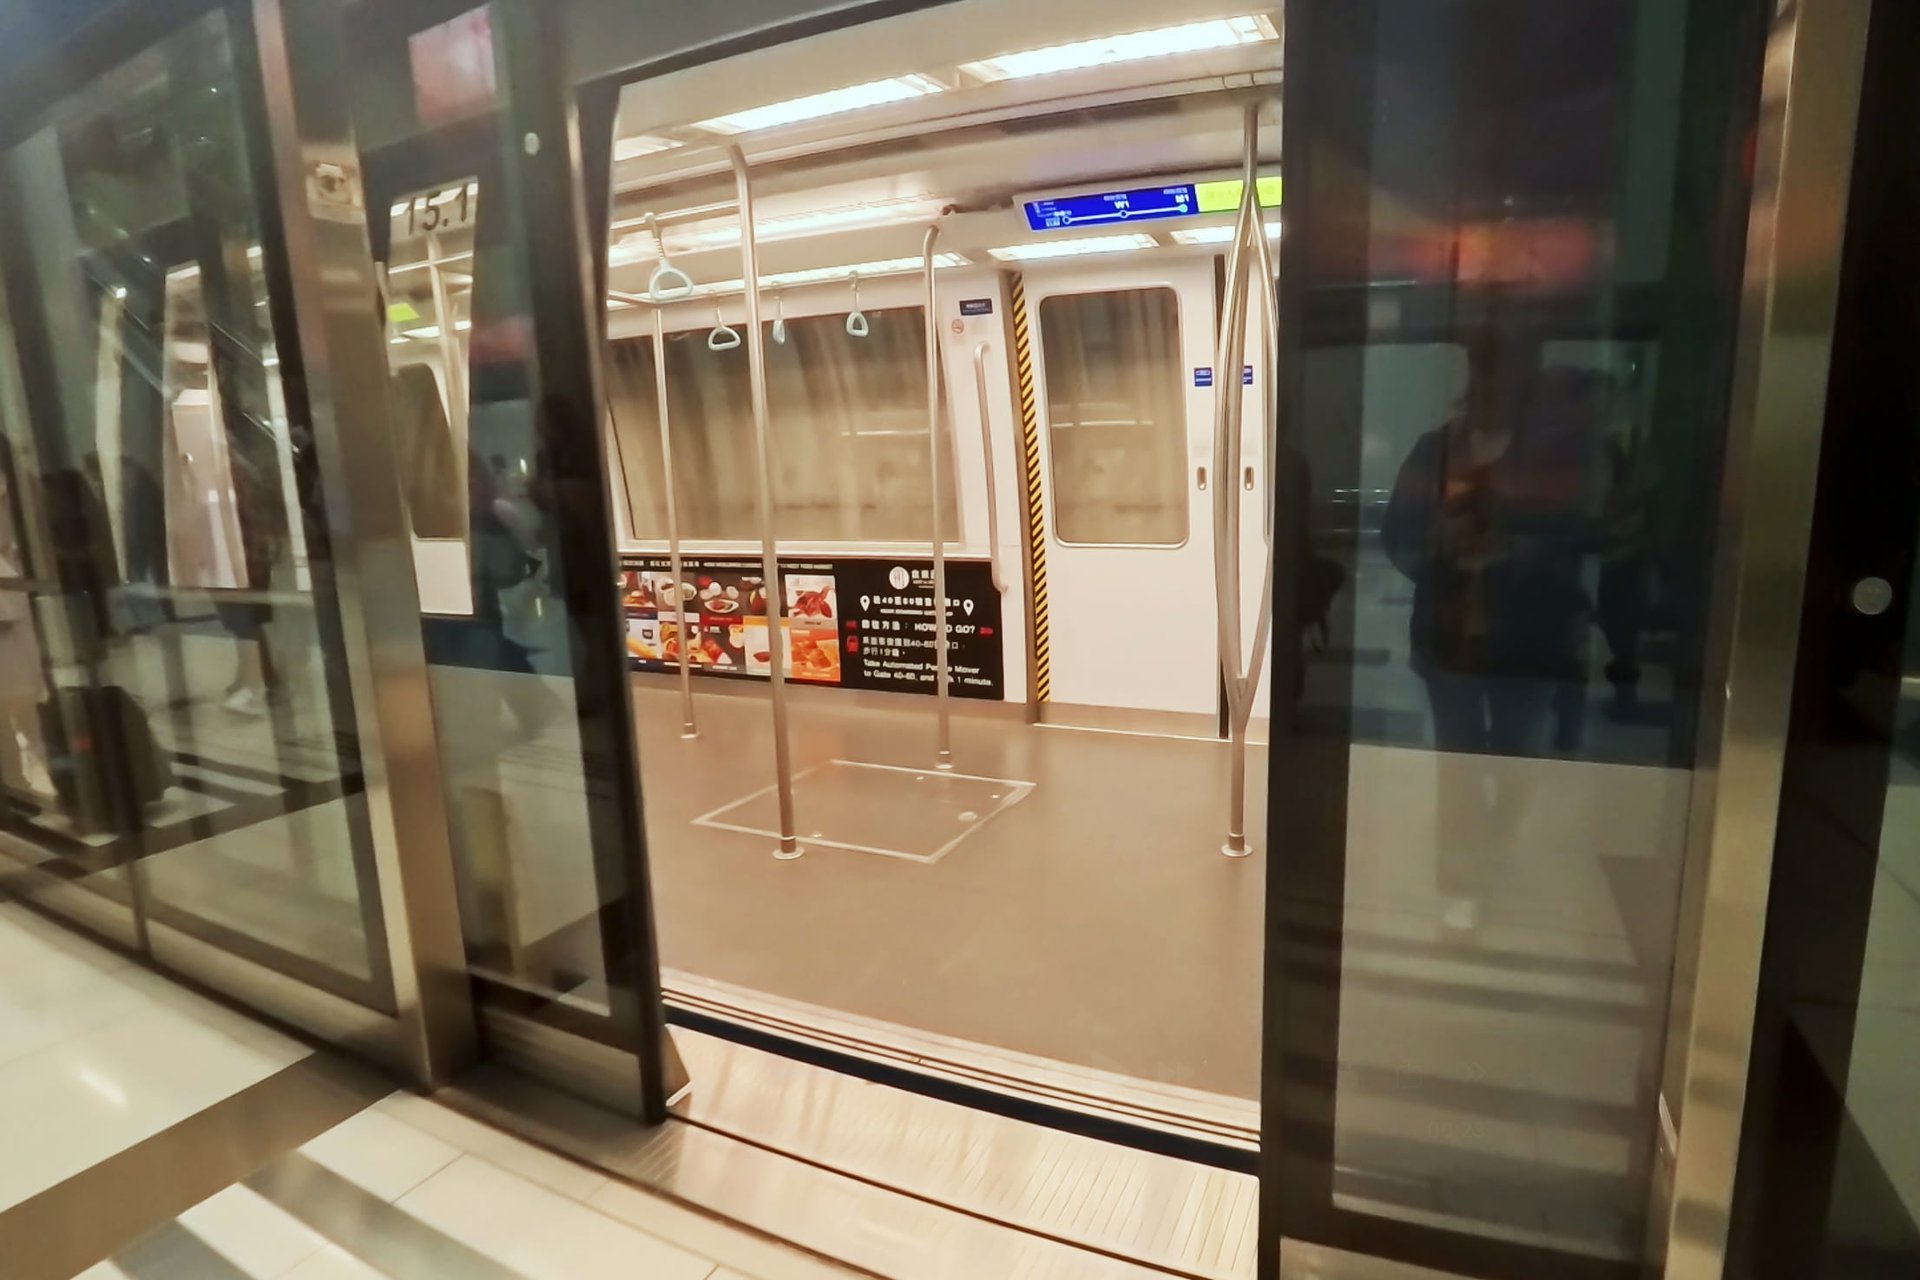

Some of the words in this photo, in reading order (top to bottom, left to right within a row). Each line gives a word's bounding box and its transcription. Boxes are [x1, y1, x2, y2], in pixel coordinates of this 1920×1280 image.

[402, 184, 467, 236] 15.1
[1114, 200, 1130, 209] W1
[955, 624, 975, 634] GO?
[863, 658, 881, 667] Take
[882, 660, 923, 670] Automated
[954, 665, 979, 674] Mover
[873, 669, 891, 678] Gate
[920, 674, 934, 682] and
